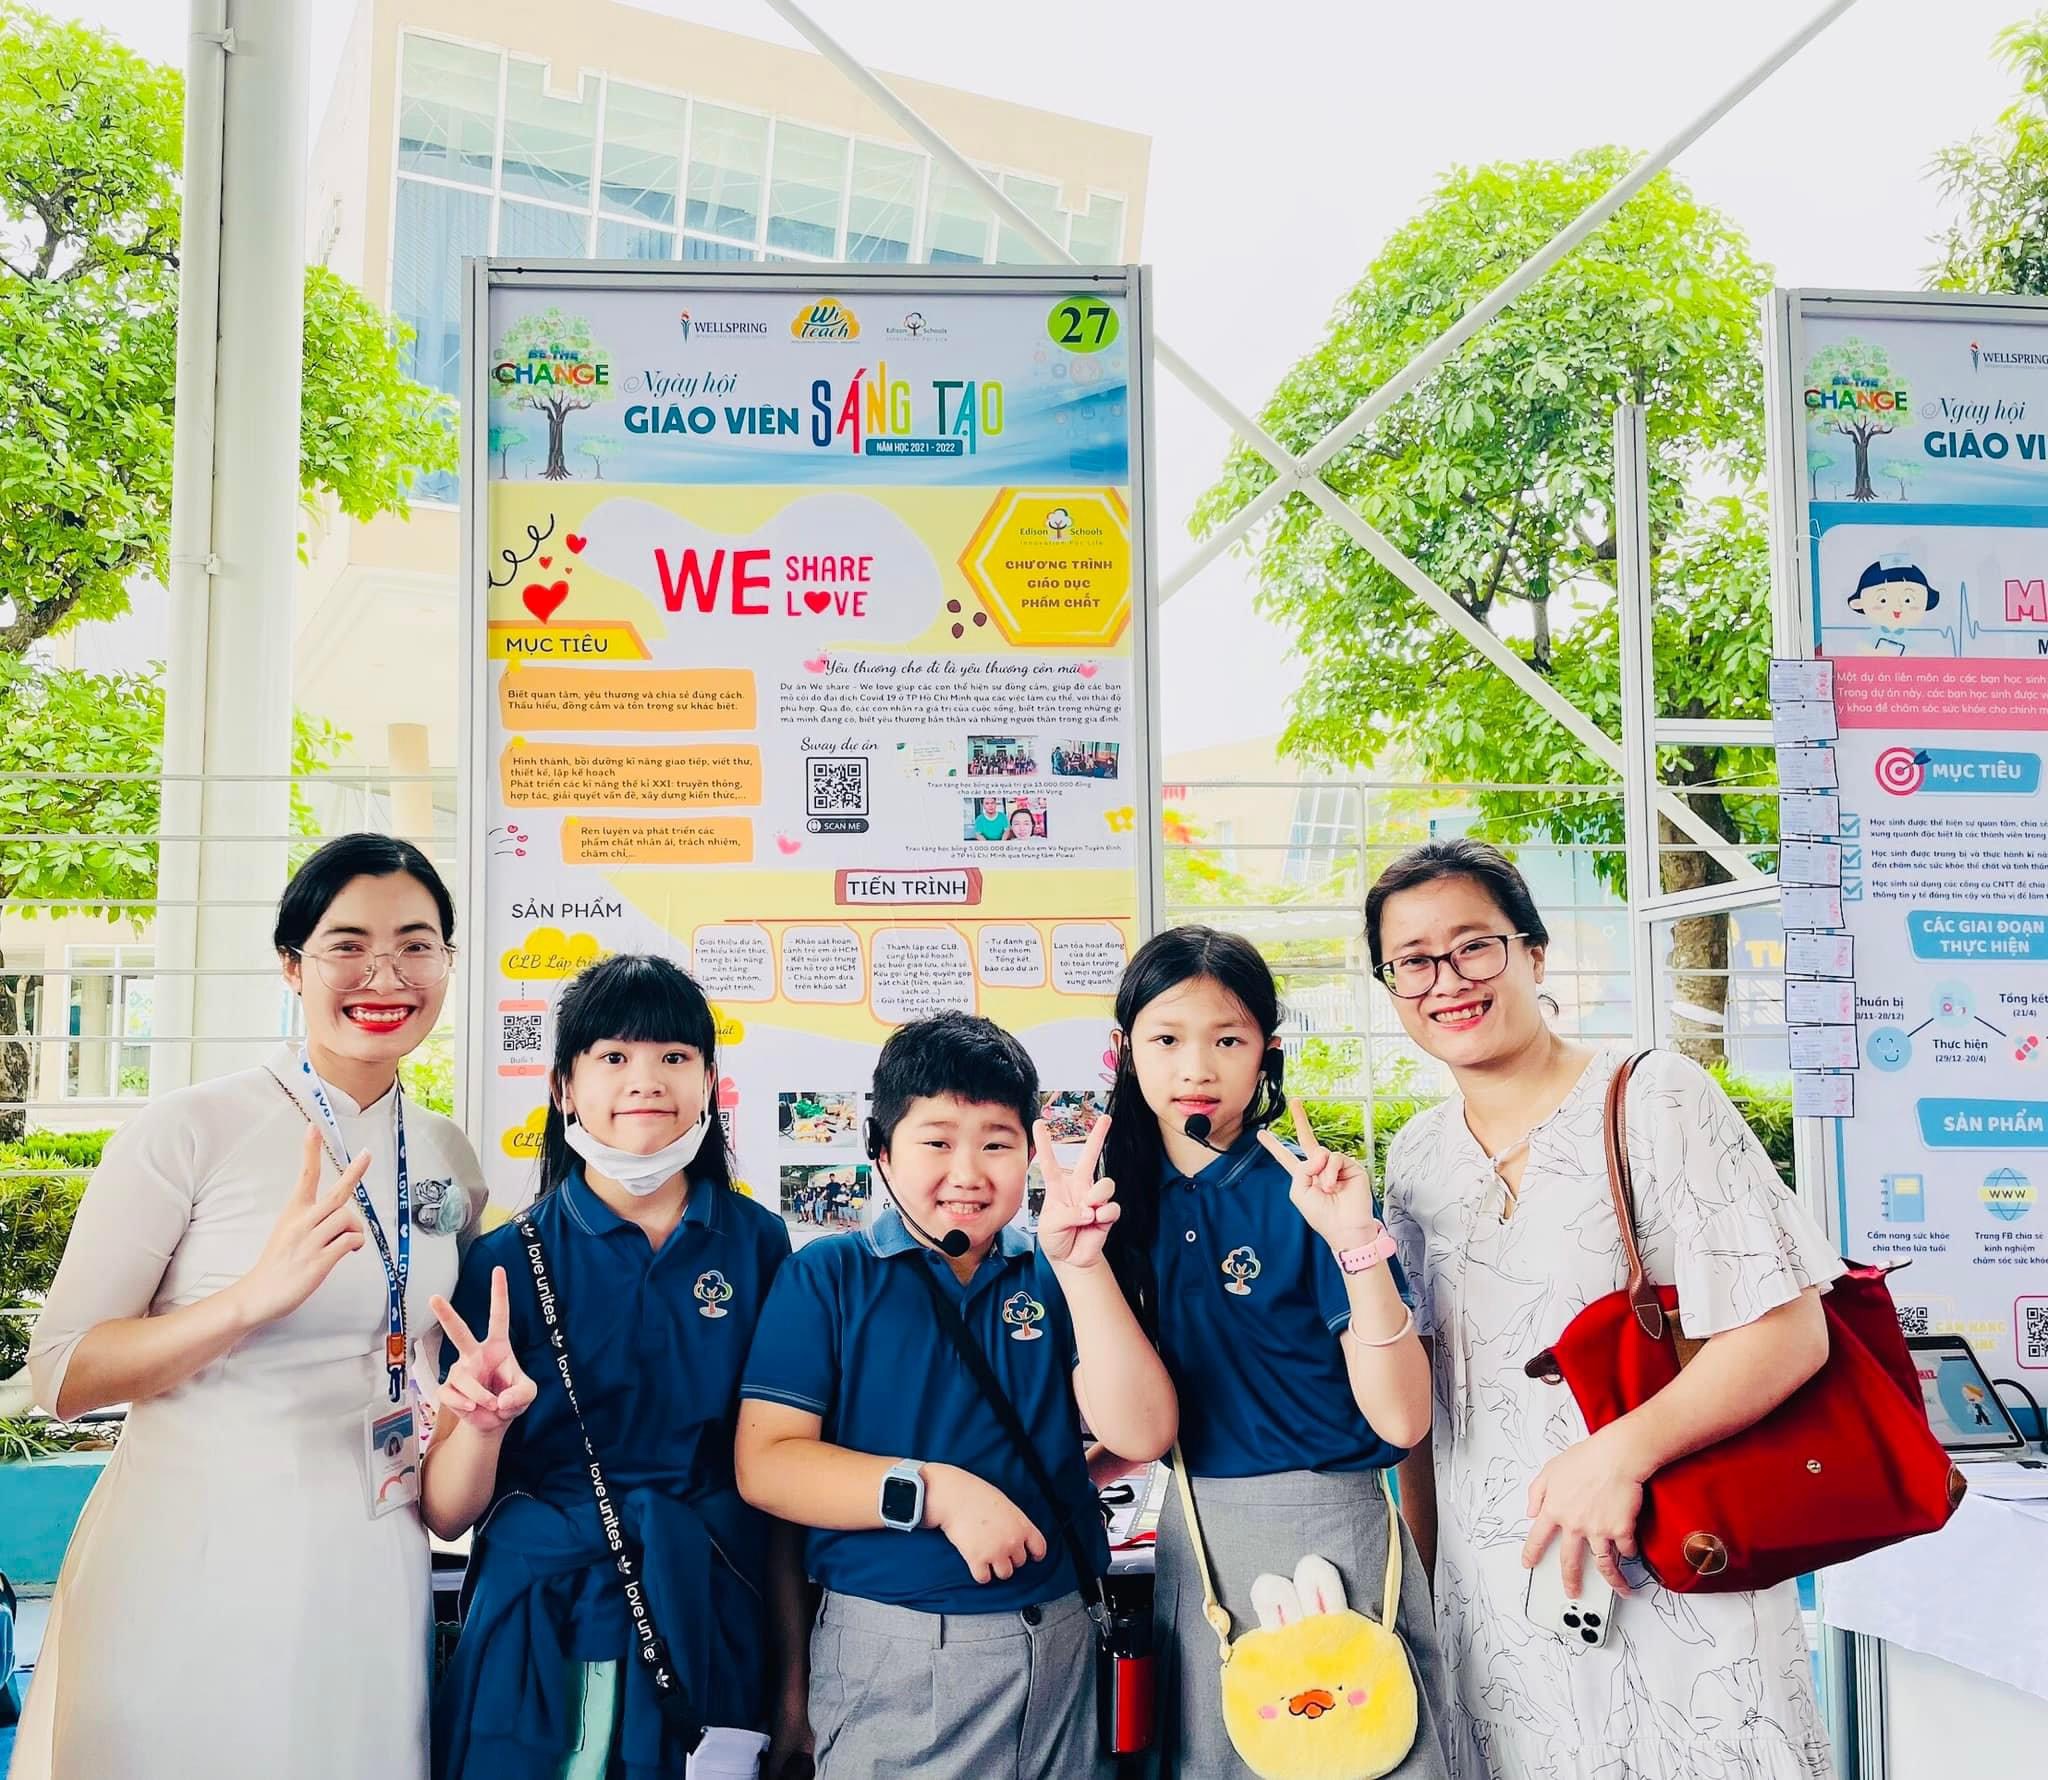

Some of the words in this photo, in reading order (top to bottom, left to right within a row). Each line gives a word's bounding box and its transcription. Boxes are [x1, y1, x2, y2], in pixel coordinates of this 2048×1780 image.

[694, 321, 767, 333] WELLSPRING
[801, 322, 848, 338] Teach
[1059, 307, 1110, 344] 27
[493, 363, 609, 385] CHANGE
[623, 370, 696, 398] Ngày
[703, 372, 738, 398] hội
[812, 360, 911, 454] SÁNG
[932, 380, 1003, 454] TẠO
[1804, 389, 1907, 412] CHANGE
[1922, 397, 1990, 424] Ngày
[1995, 400, 2026, 424] hội
[624, 402, 716, 435] GIÁO
[724, 402, 798, 435] VIÊN
[876, 442, 893, 452] NĂM
[894, 442, 909, 453] HỌC
[910, 442, 929, 452] 2021
[936, 442, 955, 452] 2022
[1924, 429, 2008, 460] GIÁO
[1020, 528, 1048, 536] Edison
[1070, 528, 1102, 536] Schools
[785, 556, 873, 582] SHARE
[1005, 559, 1067, 569] CHƯƠNG
[1072, 558, 1112, 569] TRÌNH
[654, 548, 770, 614] WE
[1028, 577, 1060, 588] GIÁO
[1064, 579, 1091, 590] DỤC
[506, 638, 553, 653] MỤC
[560, 633, 608, 653] TIÊU
[1933, 764, 1974, 783] MỤC
[1978, 760, 2021, 779] TIÊU
[848, 876, 895, 895] TIẾN
[902, 878, 966, 895] TRÌNH
[512, 897, 554, 918] SẢN
[562, 897, 622, 918] PHẨM
[1923, 916, 1956, 933] CÁC
[1959, 919, 1993, 933] GIAI
[1997, 919, 2044, 937] ĐOẠN
[1940, 940, 1987, 956] THỰC
[1991, 939, 2030, 957] HIỆN
[1933, 1038, 1961, 1049] Thực
[1965, 1038, 1988, 1051] hiện
[1944, 1111, 1983, 1132] SẢN
[1988, 1108, 2043, 1132] PHẨM
[398, 1171, 409, 1211] LOVE
[527, 1243, 545, 1275] love
[536, 1276, 557, 1325] unites
[557, 1354, 572, 1389] love
[589, 1462, 606, 1497] love
[599, 1497, 622, 1551] unites
[624, 1580, 645, 1618] love
